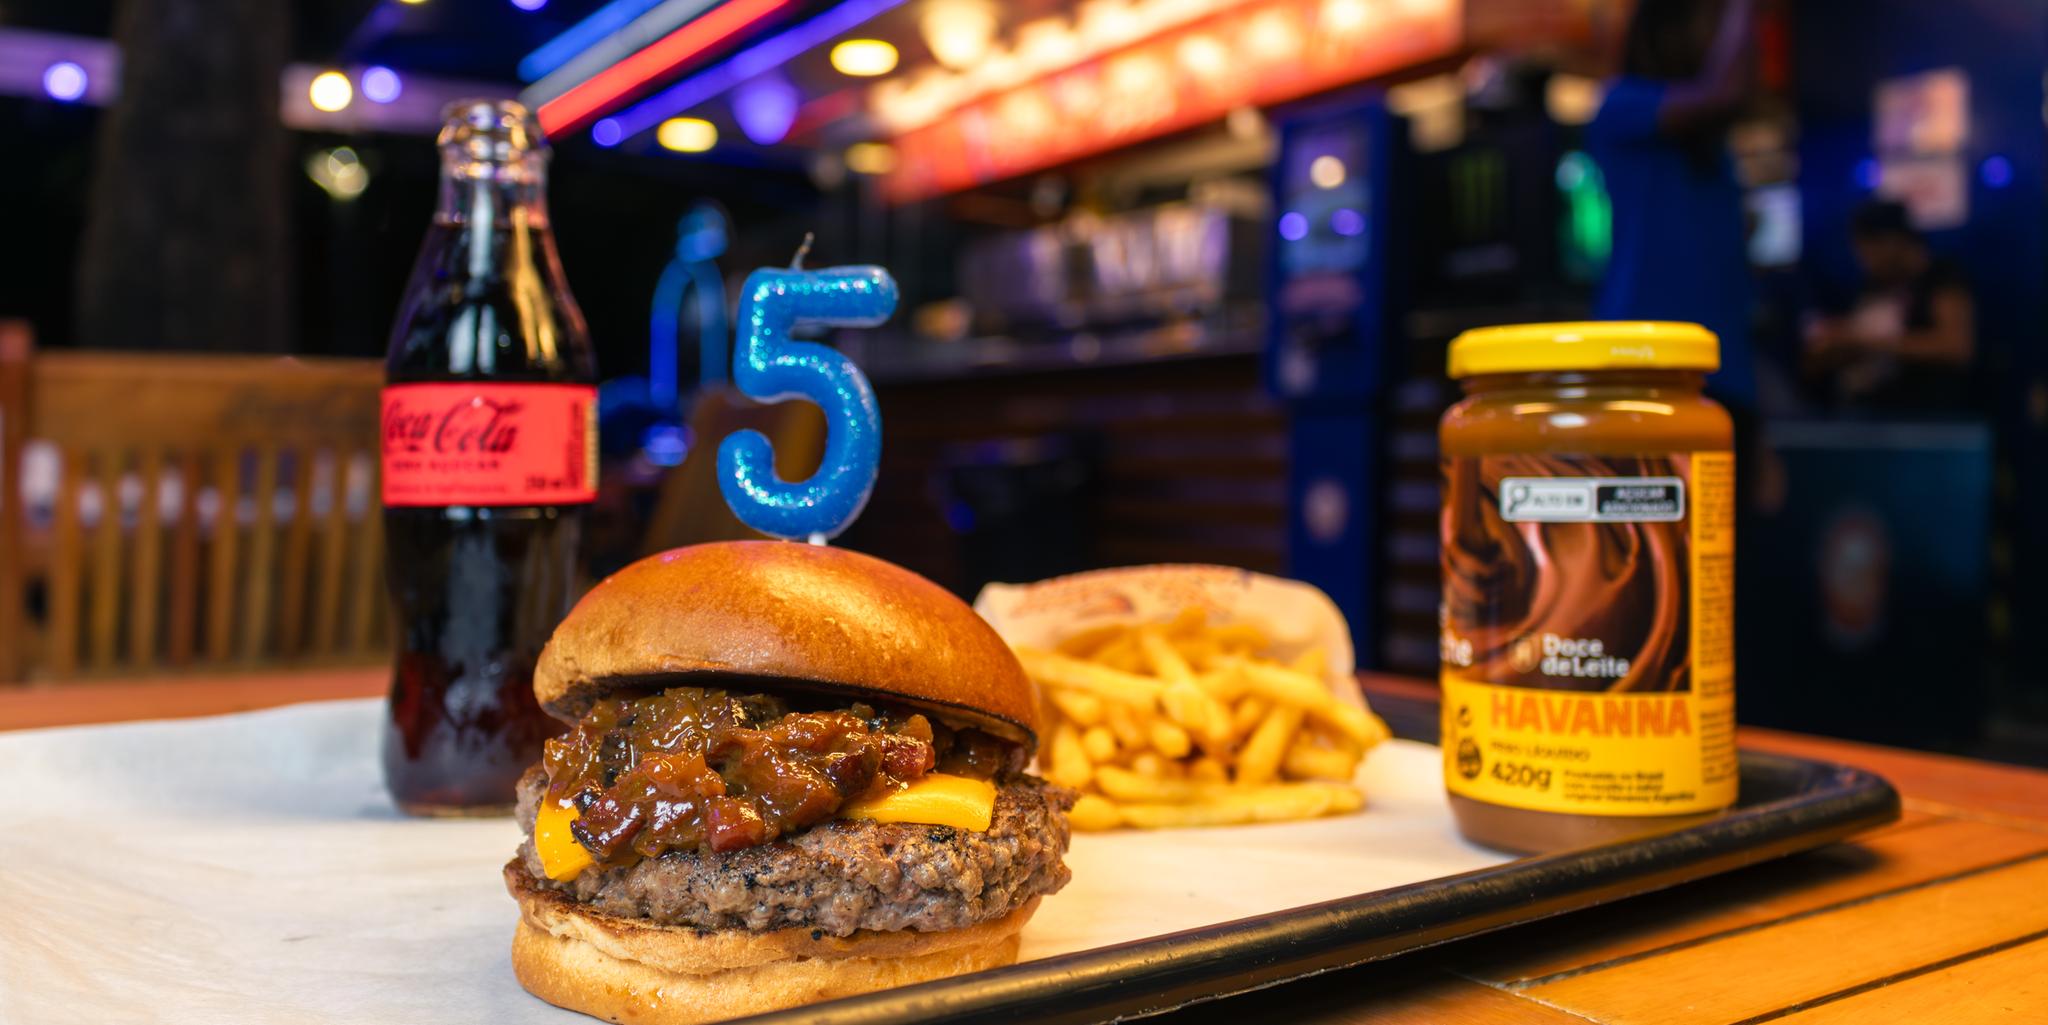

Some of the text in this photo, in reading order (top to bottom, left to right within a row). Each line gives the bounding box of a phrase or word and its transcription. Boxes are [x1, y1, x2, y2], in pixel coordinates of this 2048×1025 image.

[717, 265, 898, 538] 5
[1542, 632, 1603, 657] Doce
[1490, 692, 1692, 737] HAVANNA
[1491, 761, 1553, 790] 420g
